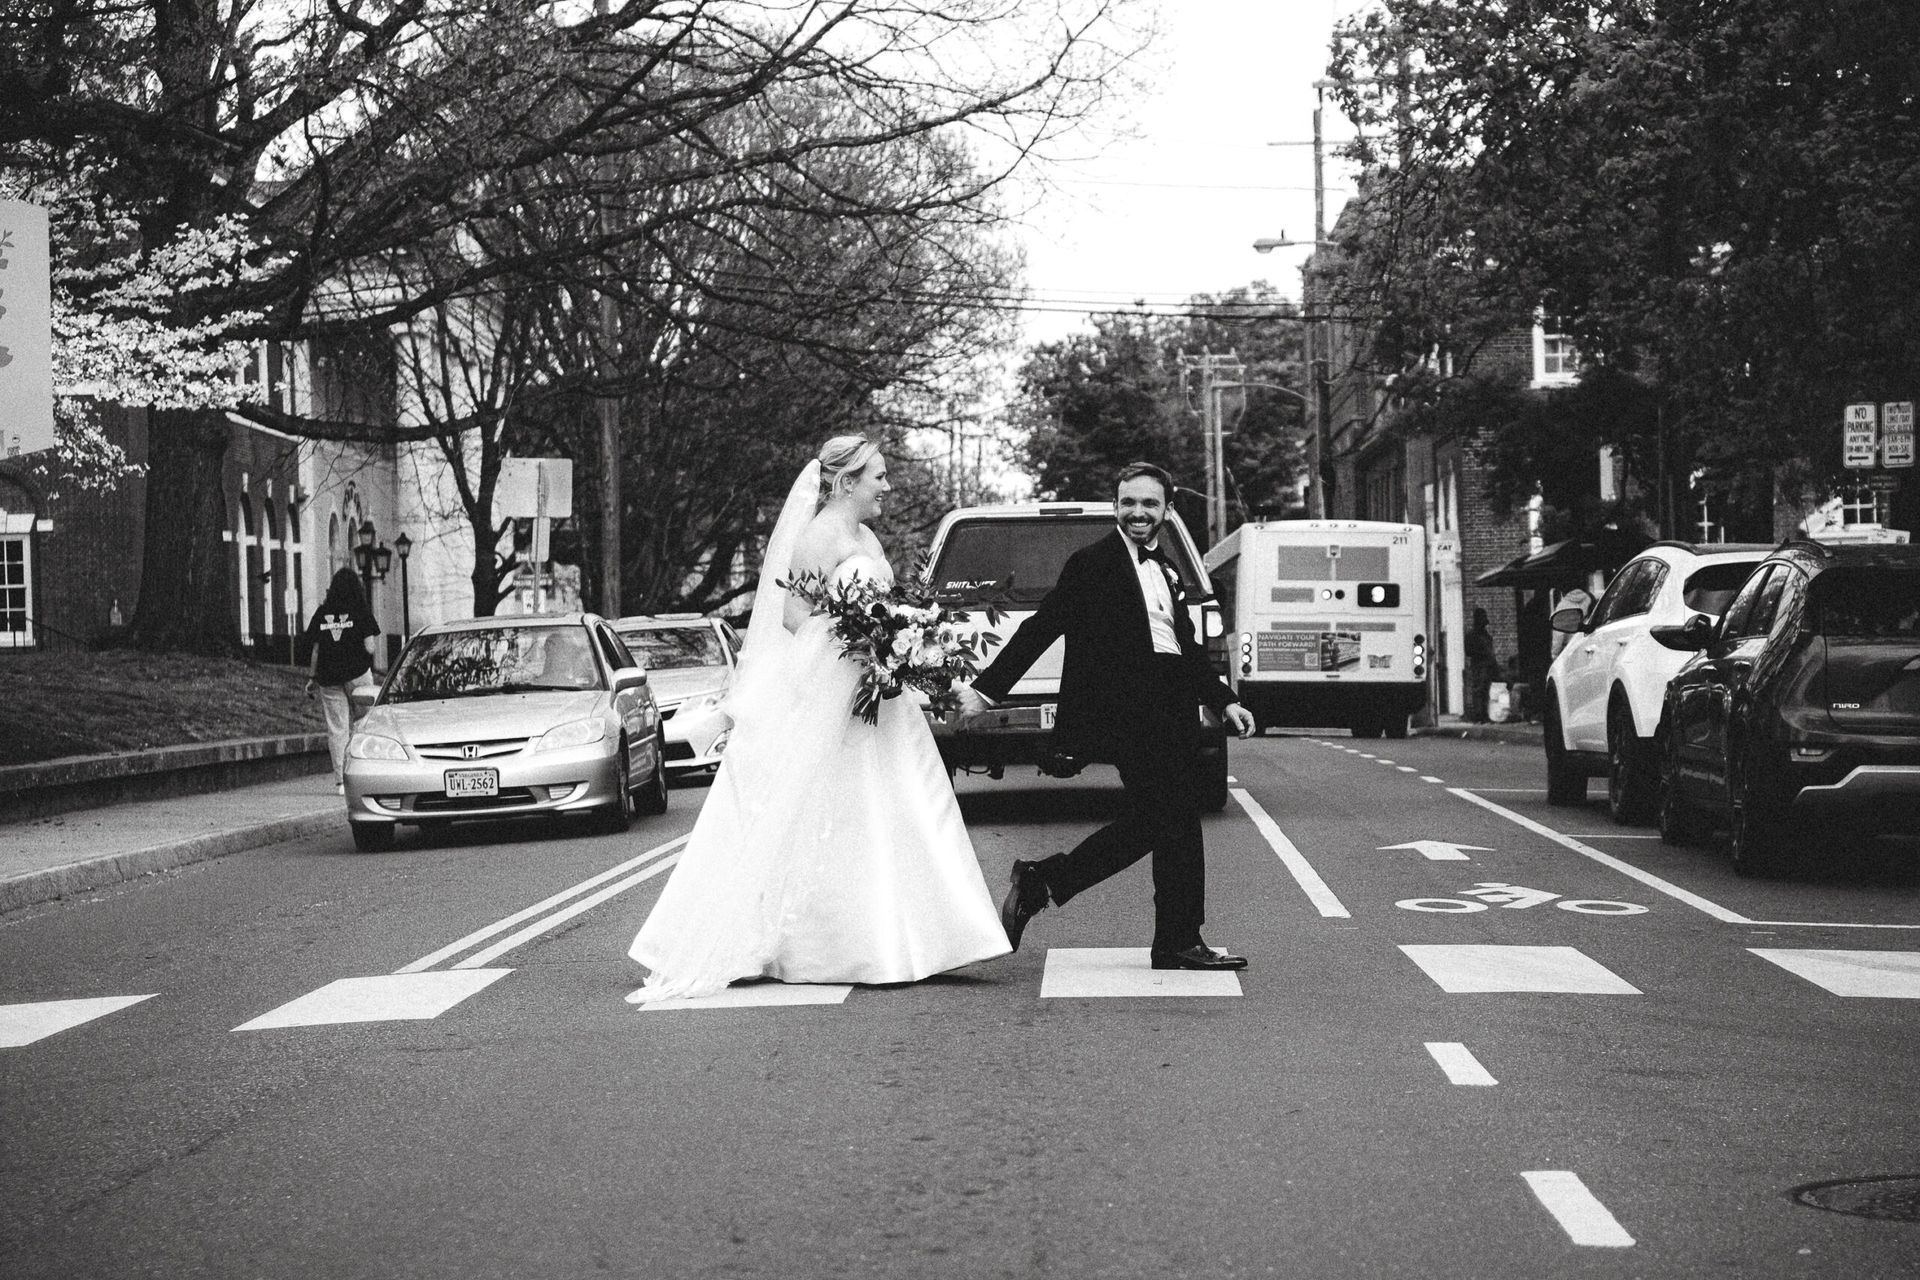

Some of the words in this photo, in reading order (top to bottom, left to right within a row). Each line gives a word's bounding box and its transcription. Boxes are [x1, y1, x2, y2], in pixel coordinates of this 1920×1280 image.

[1855, 407, 1867, 419] NO
[1848, 421, 1874, 433] PARKING
[1393, 536, 1408, 545] 211
[450, 777, 494, 790] UWL-2562
